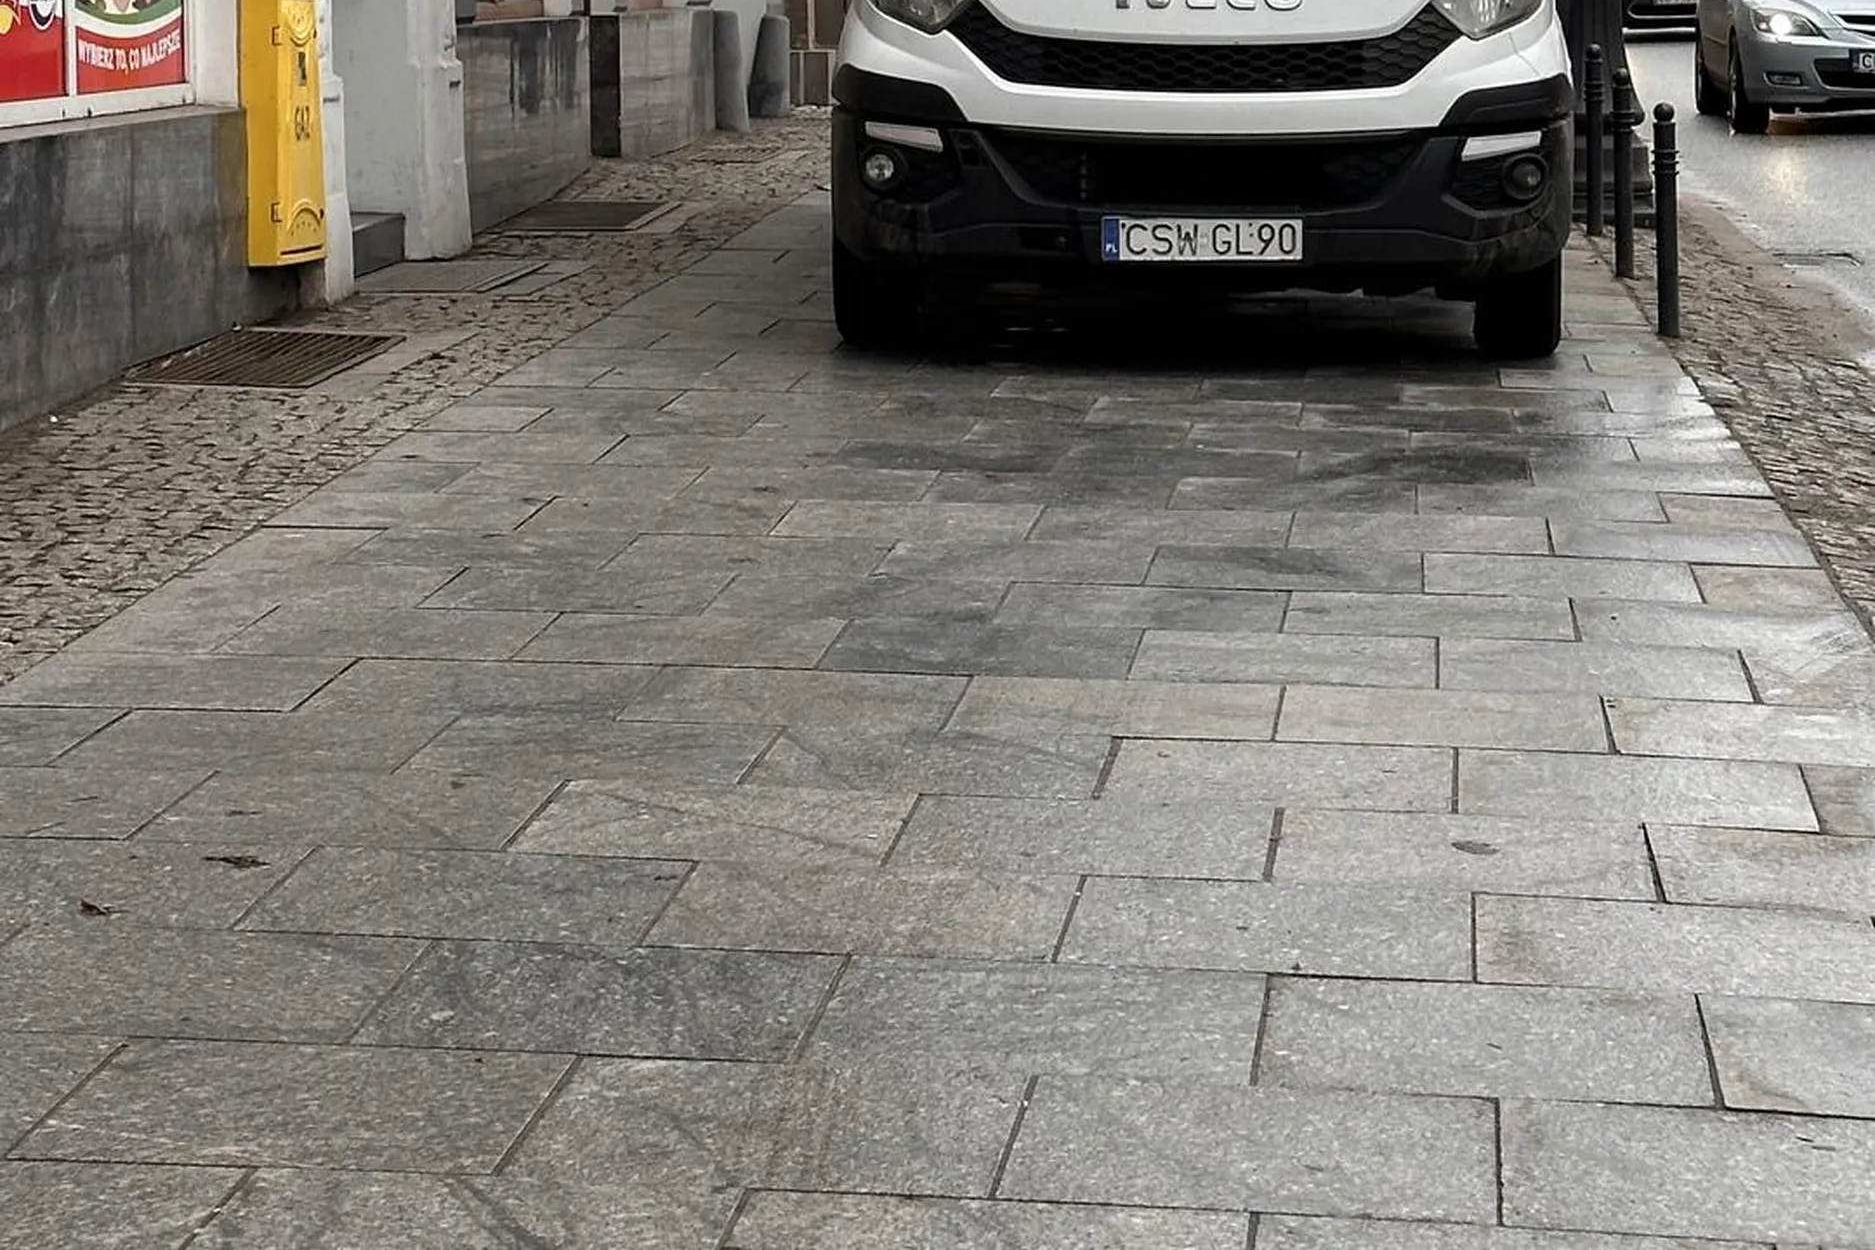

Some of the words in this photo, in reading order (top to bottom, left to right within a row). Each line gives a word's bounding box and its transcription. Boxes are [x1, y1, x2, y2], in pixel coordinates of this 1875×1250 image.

[129, 48, 140, 70] CO
[1125, 223, 1198, 256] CSW
[1212, 223, 1297, 256] GL90
